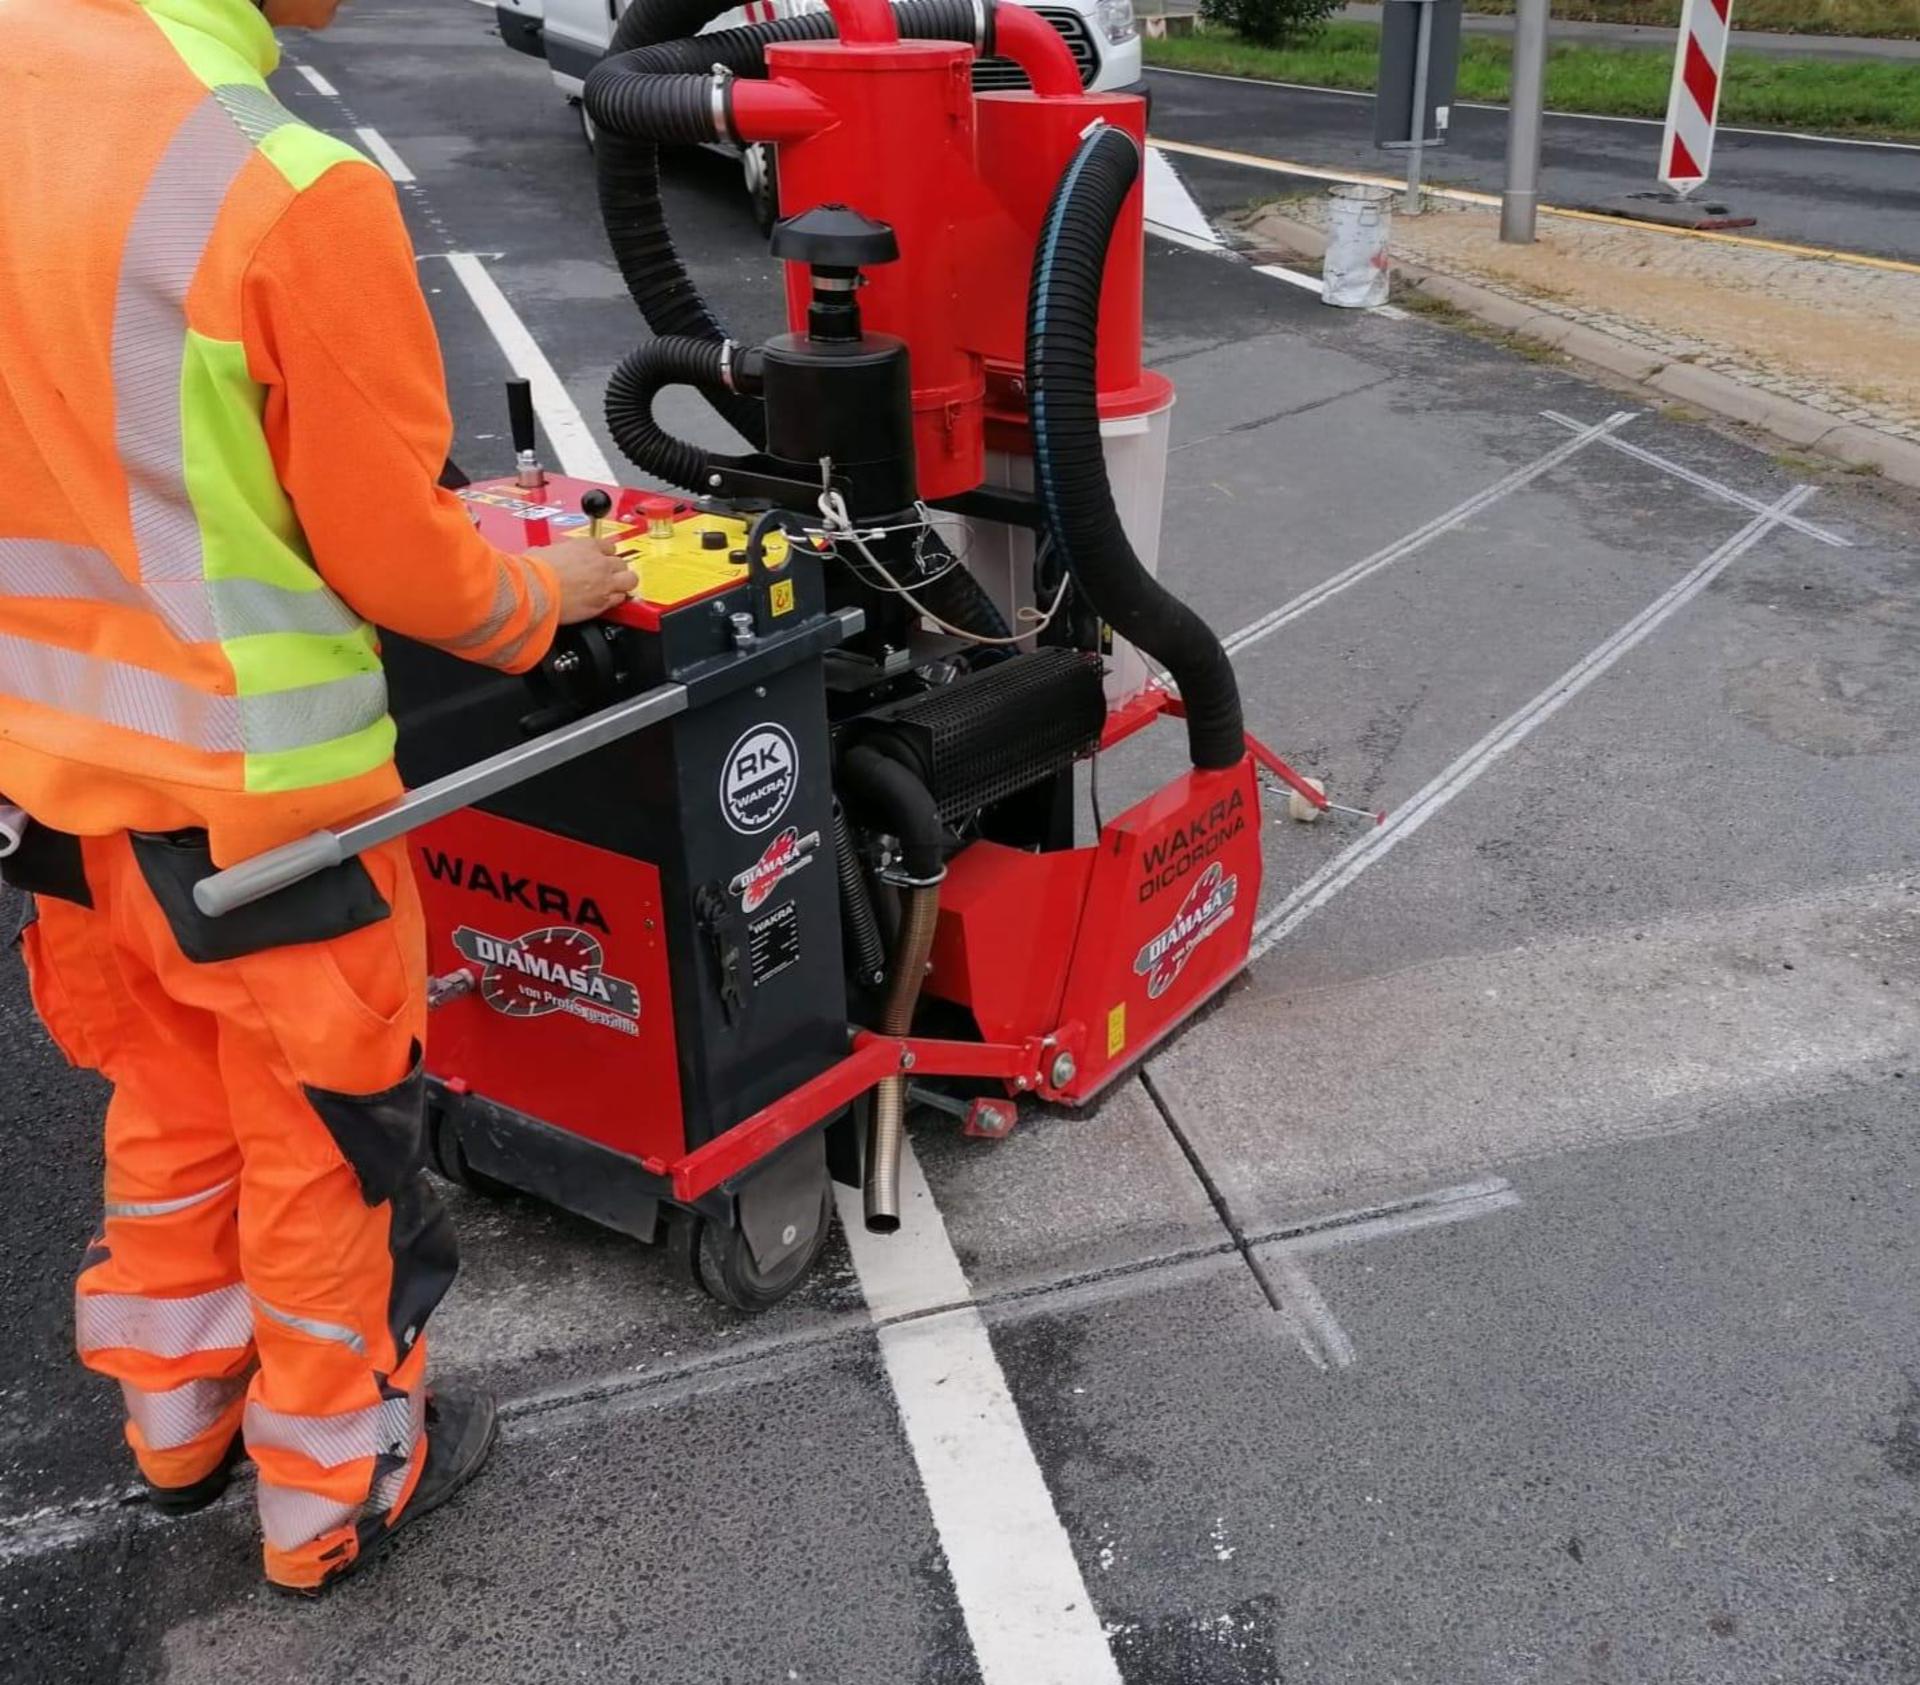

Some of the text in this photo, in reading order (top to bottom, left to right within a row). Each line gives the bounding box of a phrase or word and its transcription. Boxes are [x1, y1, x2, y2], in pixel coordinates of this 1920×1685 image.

[737, 742, 781, 782] RK
[736, 779, 785, 808] WAKRA
[1142, 787, 1244, 874] WAKRA
[740, 847, 800, 888] DIAMASA
[1139, 816, 1245, 903] DICORONA
[422, 847, 612, 936] WAKRA
[753, 906, 794, 934] WAKRA
